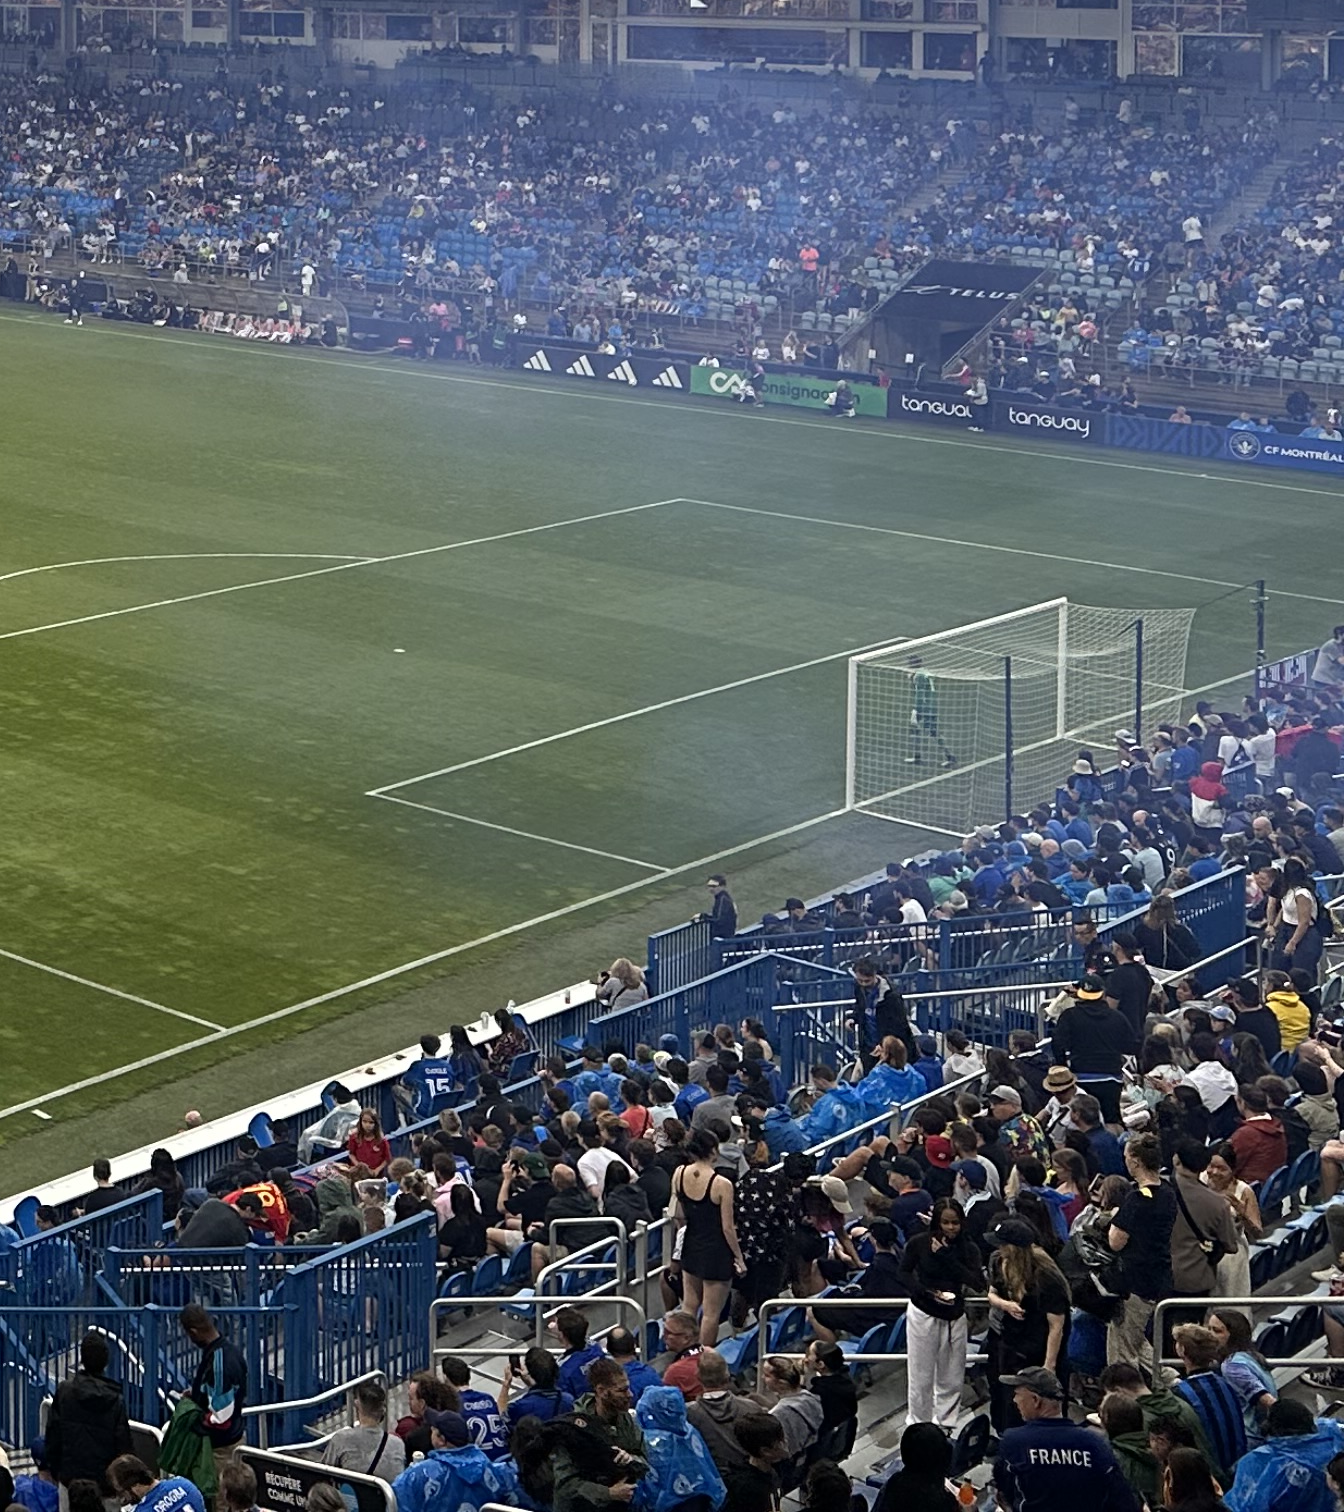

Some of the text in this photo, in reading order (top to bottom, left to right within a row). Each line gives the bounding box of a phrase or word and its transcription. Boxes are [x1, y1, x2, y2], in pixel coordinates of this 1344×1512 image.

[949, 288, 1019, 301] TELUS
[901, 394, 973, 419] tangua
[1009, 406, 1091, 438] tanguay
[1264, 445, 1344, 463] CF MONTRÉAL
[425, 1078, 450, 1099] 15
[1029, 1448, 1092, 1468] FRANCE
